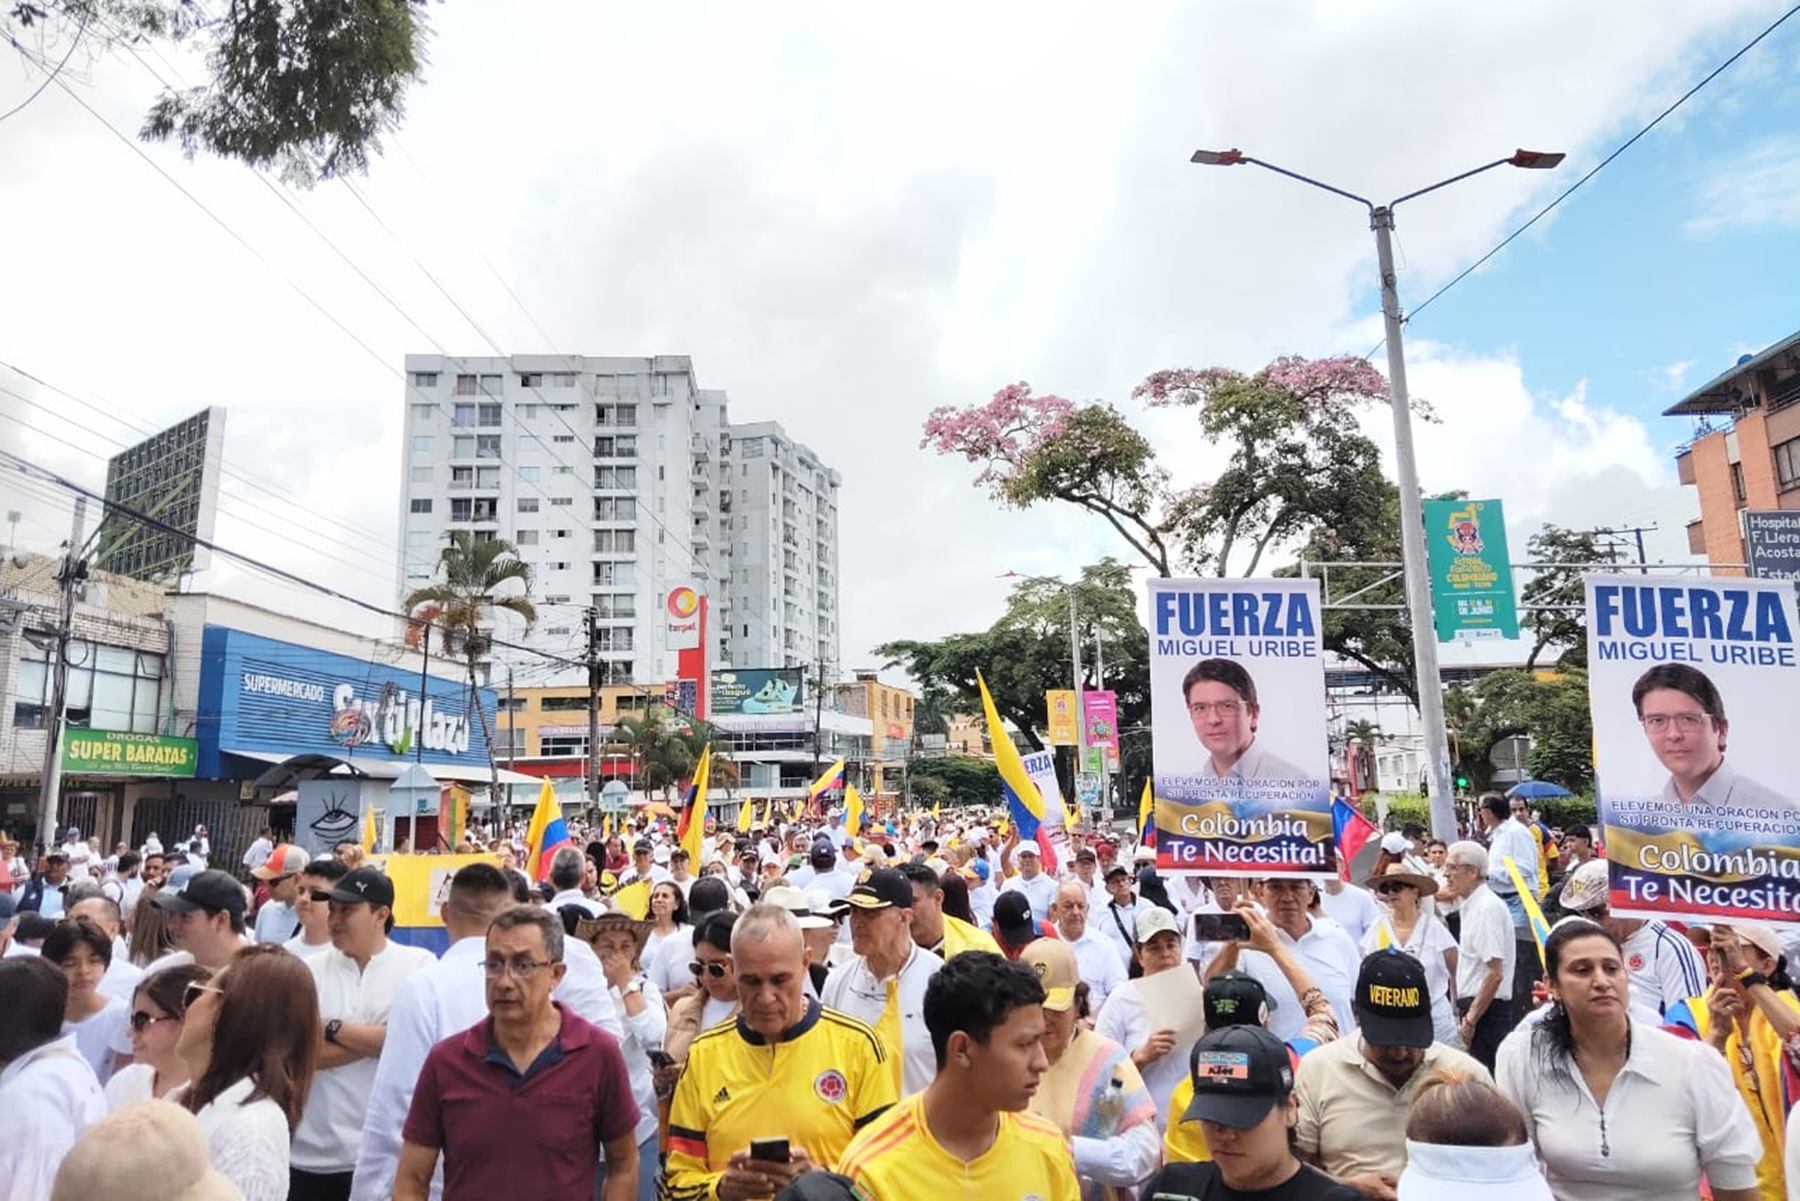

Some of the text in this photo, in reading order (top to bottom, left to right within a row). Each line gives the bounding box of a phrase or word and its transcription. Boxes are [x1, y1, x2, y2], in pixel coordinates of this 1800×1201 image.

[1750, 515, 1800, 530] Hospital
[1764, 530, 1800, 543] Llera
[1755, 545, 1800, 558] Acosta
[1757, 566, 1800, 581] Estad
[1156, 592, 1315, 636] FUERZA
[1595, 586, 1793, 643] FUERZA
[1158, 640, 1316, 657] MIGUEL URIBE
[1598, 641, 1796, 667] MIGUEL URIBE
[243, 673, 325, 702] SUPERMERCADO
[106, 732, 160, 743] DROGAS
[69, 739, 188, 765] SUPER BARATAS
[1024, 754, 1052, 774] ERZA
[1162, 778, 1221, 787] ELEVEMOS
[1222, 778, 1243, 787] UNA
[1298, 780, 1320, 789] POR
[1186, 789, 1228, 799] PRONTA
[1612, 800, 1800, 822] ELEVEMOS UNA ORACIÓN PO
[1619, 814, 1639, 825] SU
[1643, 815, 1694, 828] PRONTA
[1181, 812, 1309, 837] Colombia
[1167, 840, 1326, 865] Te Necesita!
[1639, 843, 1800, 881] Colombia
[1622, 875, 1659, 901] Te
[1369, 983, 1420, 1008] VETERANO
